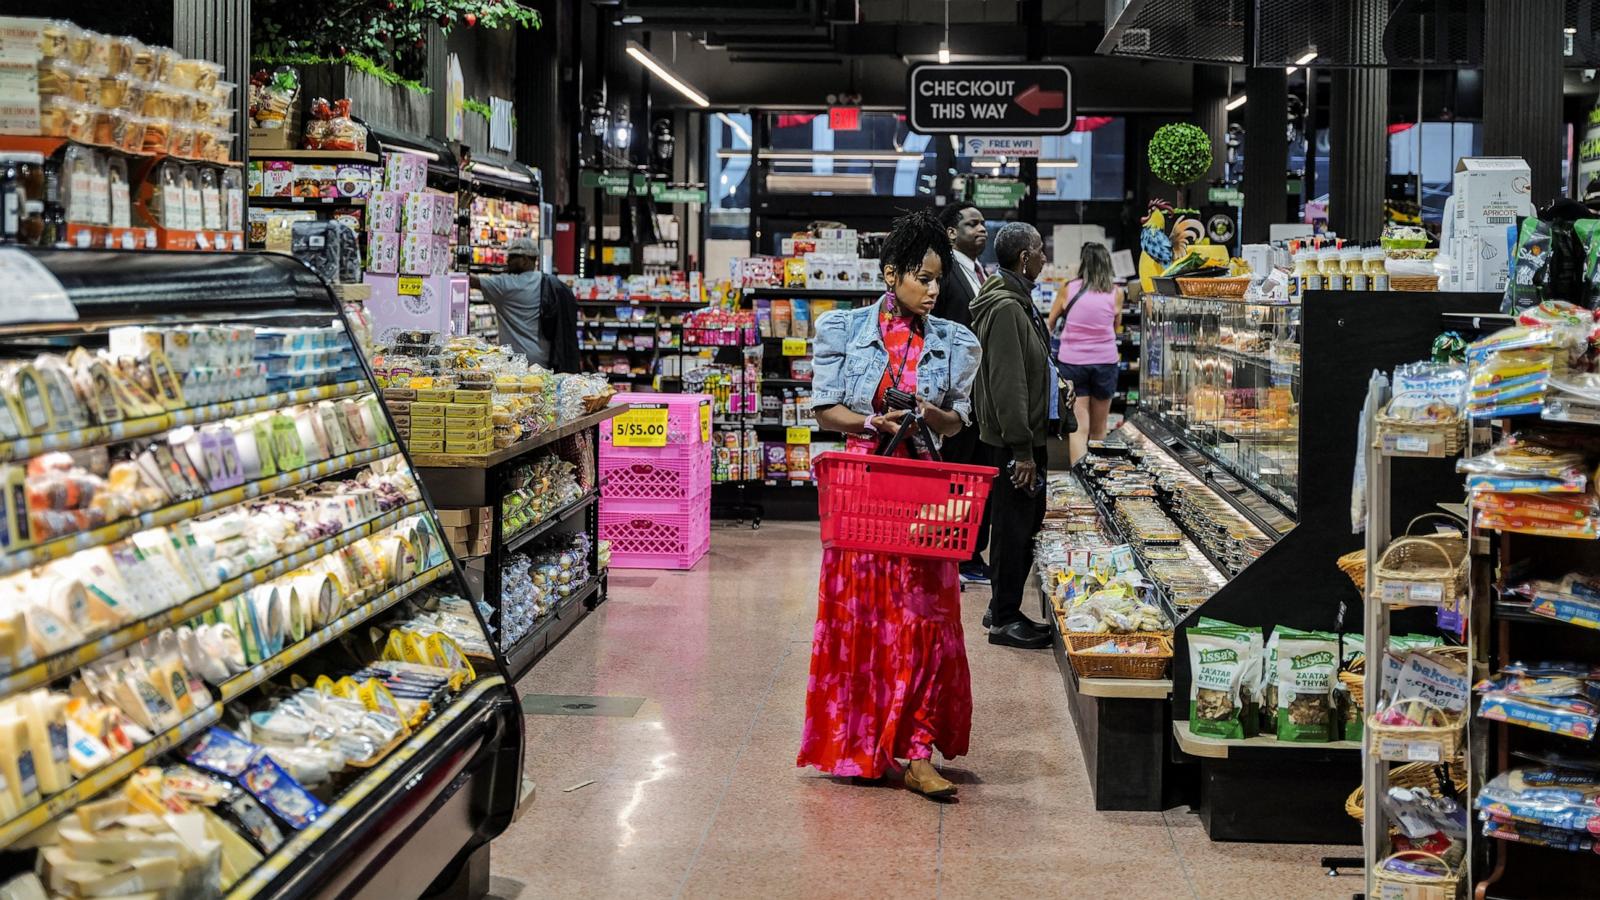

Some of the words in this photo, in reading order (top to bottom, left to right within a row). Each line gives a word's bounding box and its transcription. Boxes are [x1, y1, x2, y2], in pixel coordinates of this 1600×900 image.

[919, 80, 1015, 97] CHECKOUT
[930, 103, 966, 119] THIS
[970, 103, 1008, 119] WAY
[989, 139, 1010, 148] FREE
[1012, 139, 1033, 148] WIFI
[977, 183, 1012, 193] Midtown
[617, 423, 664, 436] 5/$5.00
[1202, 648, 1236, 662] issa's
[1295, 651, 1331, 668] issa's
[1204, 676, 1231, 685] THYME
[1412, 660, 1468, 692] bakerly
[1415, 680, 1460, 699] crêpes
